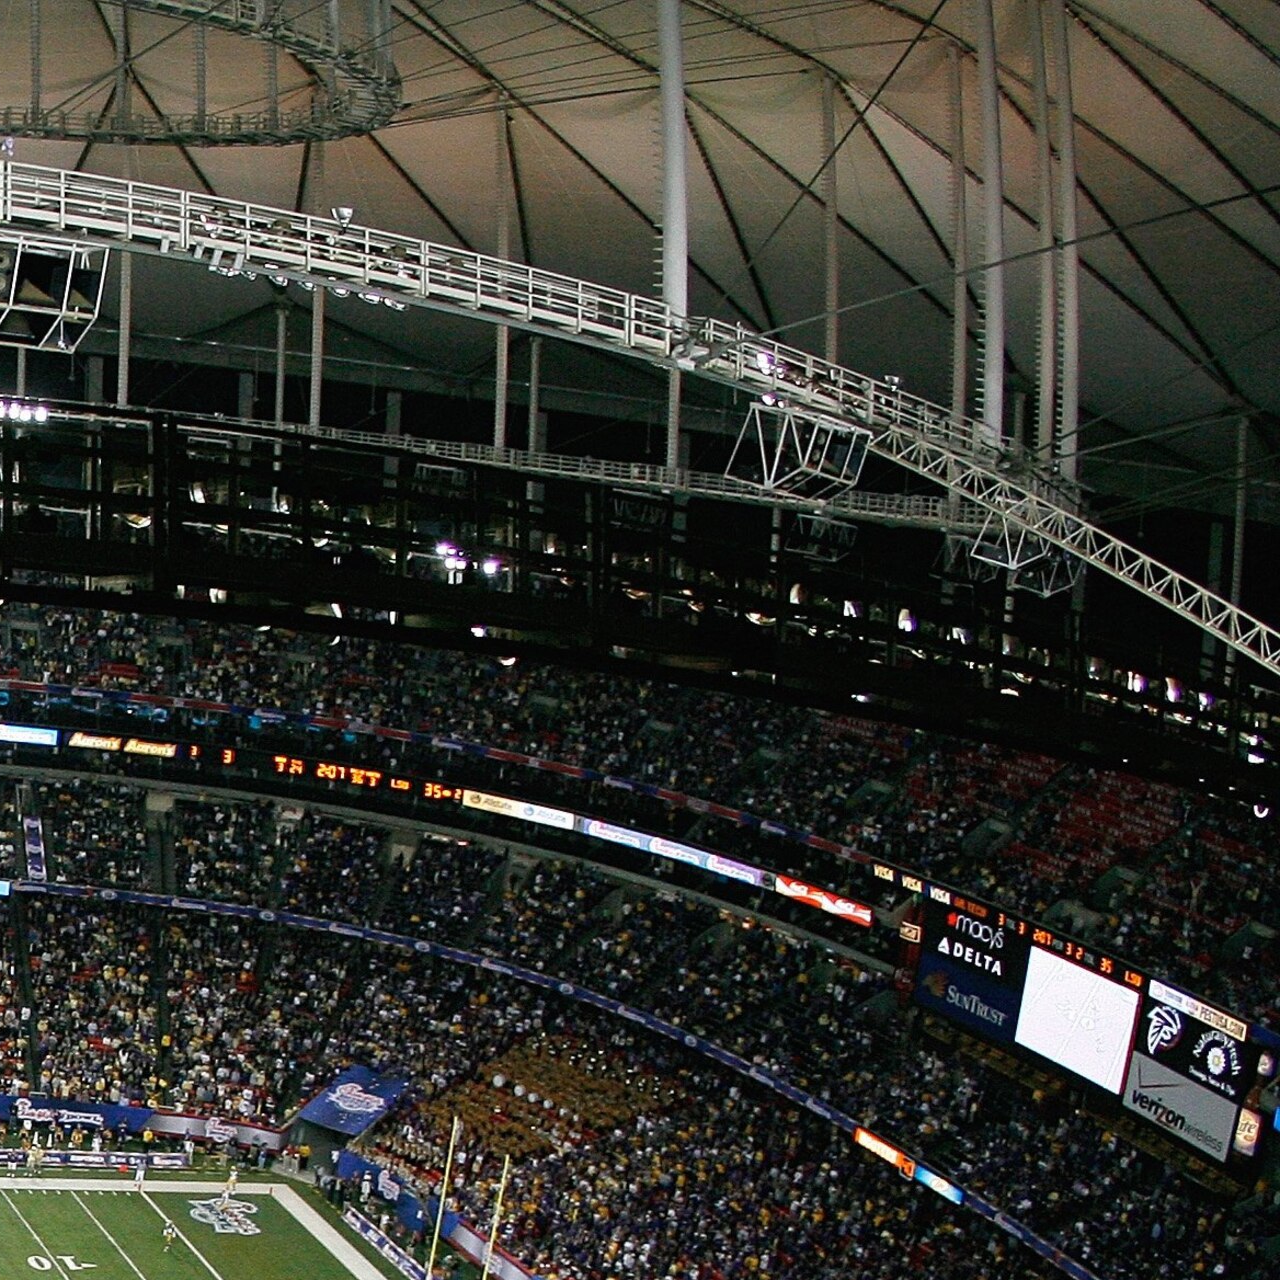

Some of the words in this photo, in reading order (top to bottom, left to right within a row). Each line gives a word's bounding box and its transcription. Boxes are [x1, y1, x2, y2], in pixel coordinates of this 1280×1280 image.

[223, 750, 233, 764] 3
[317, 763, 345, 779] 2:07
[424, 783, 441, 799] 35
[874, 864, 894, 882] VISA
[902, 875, 922, 893] VISA
[929, 886, 951, 905] VISA
[955, 914, 1004, 949] macy's
[952, 942, 1002, 976] DELTA
[1100, 957, 1113, 973] 35
[1132, 1089, 1186, 1131] verizon
[1184, 1122, 1224, 1153] wireless
[27, 1254, 84, 1271] 10
